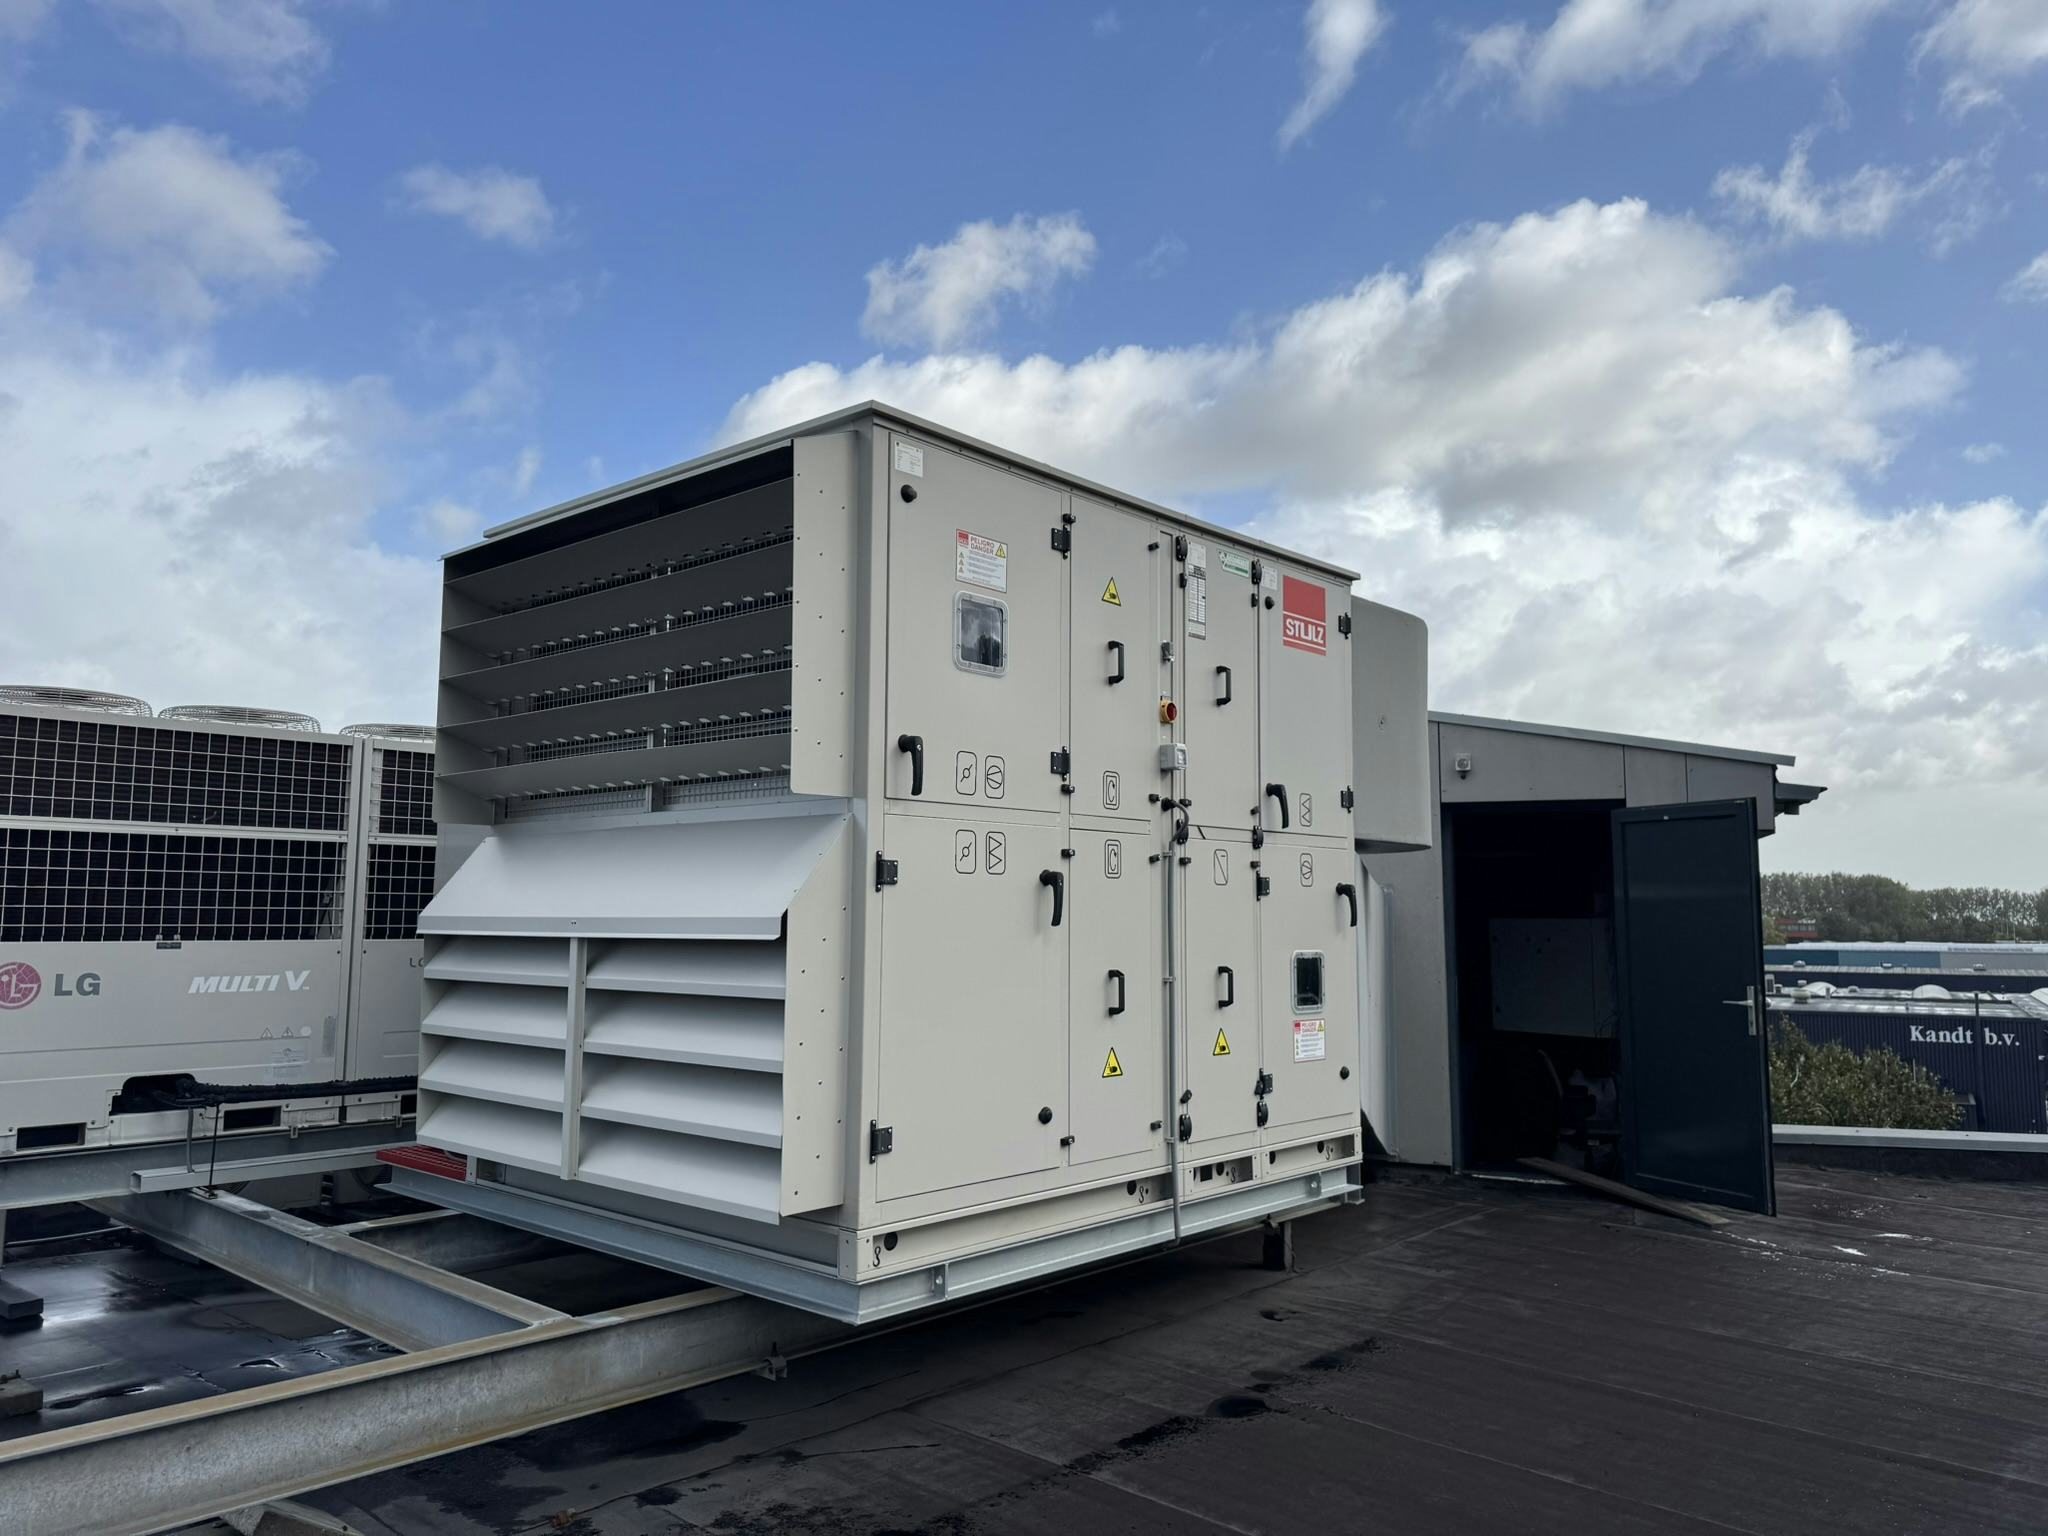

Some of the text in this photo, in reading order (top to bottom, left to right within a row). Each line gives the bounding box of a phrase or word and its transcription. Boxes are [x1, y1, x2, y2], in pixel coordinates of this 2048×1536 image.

[971, 536, 994, 548] PELIGRO
[971, 543, 994, 555] DANGER
[1286, 618, 1324, 644] STULZ
[54, 972, 101, 996] LG
[186, 974, 280, 994] MULTI
[1909, 1025, 2020, 1046] Kandt b.v.
